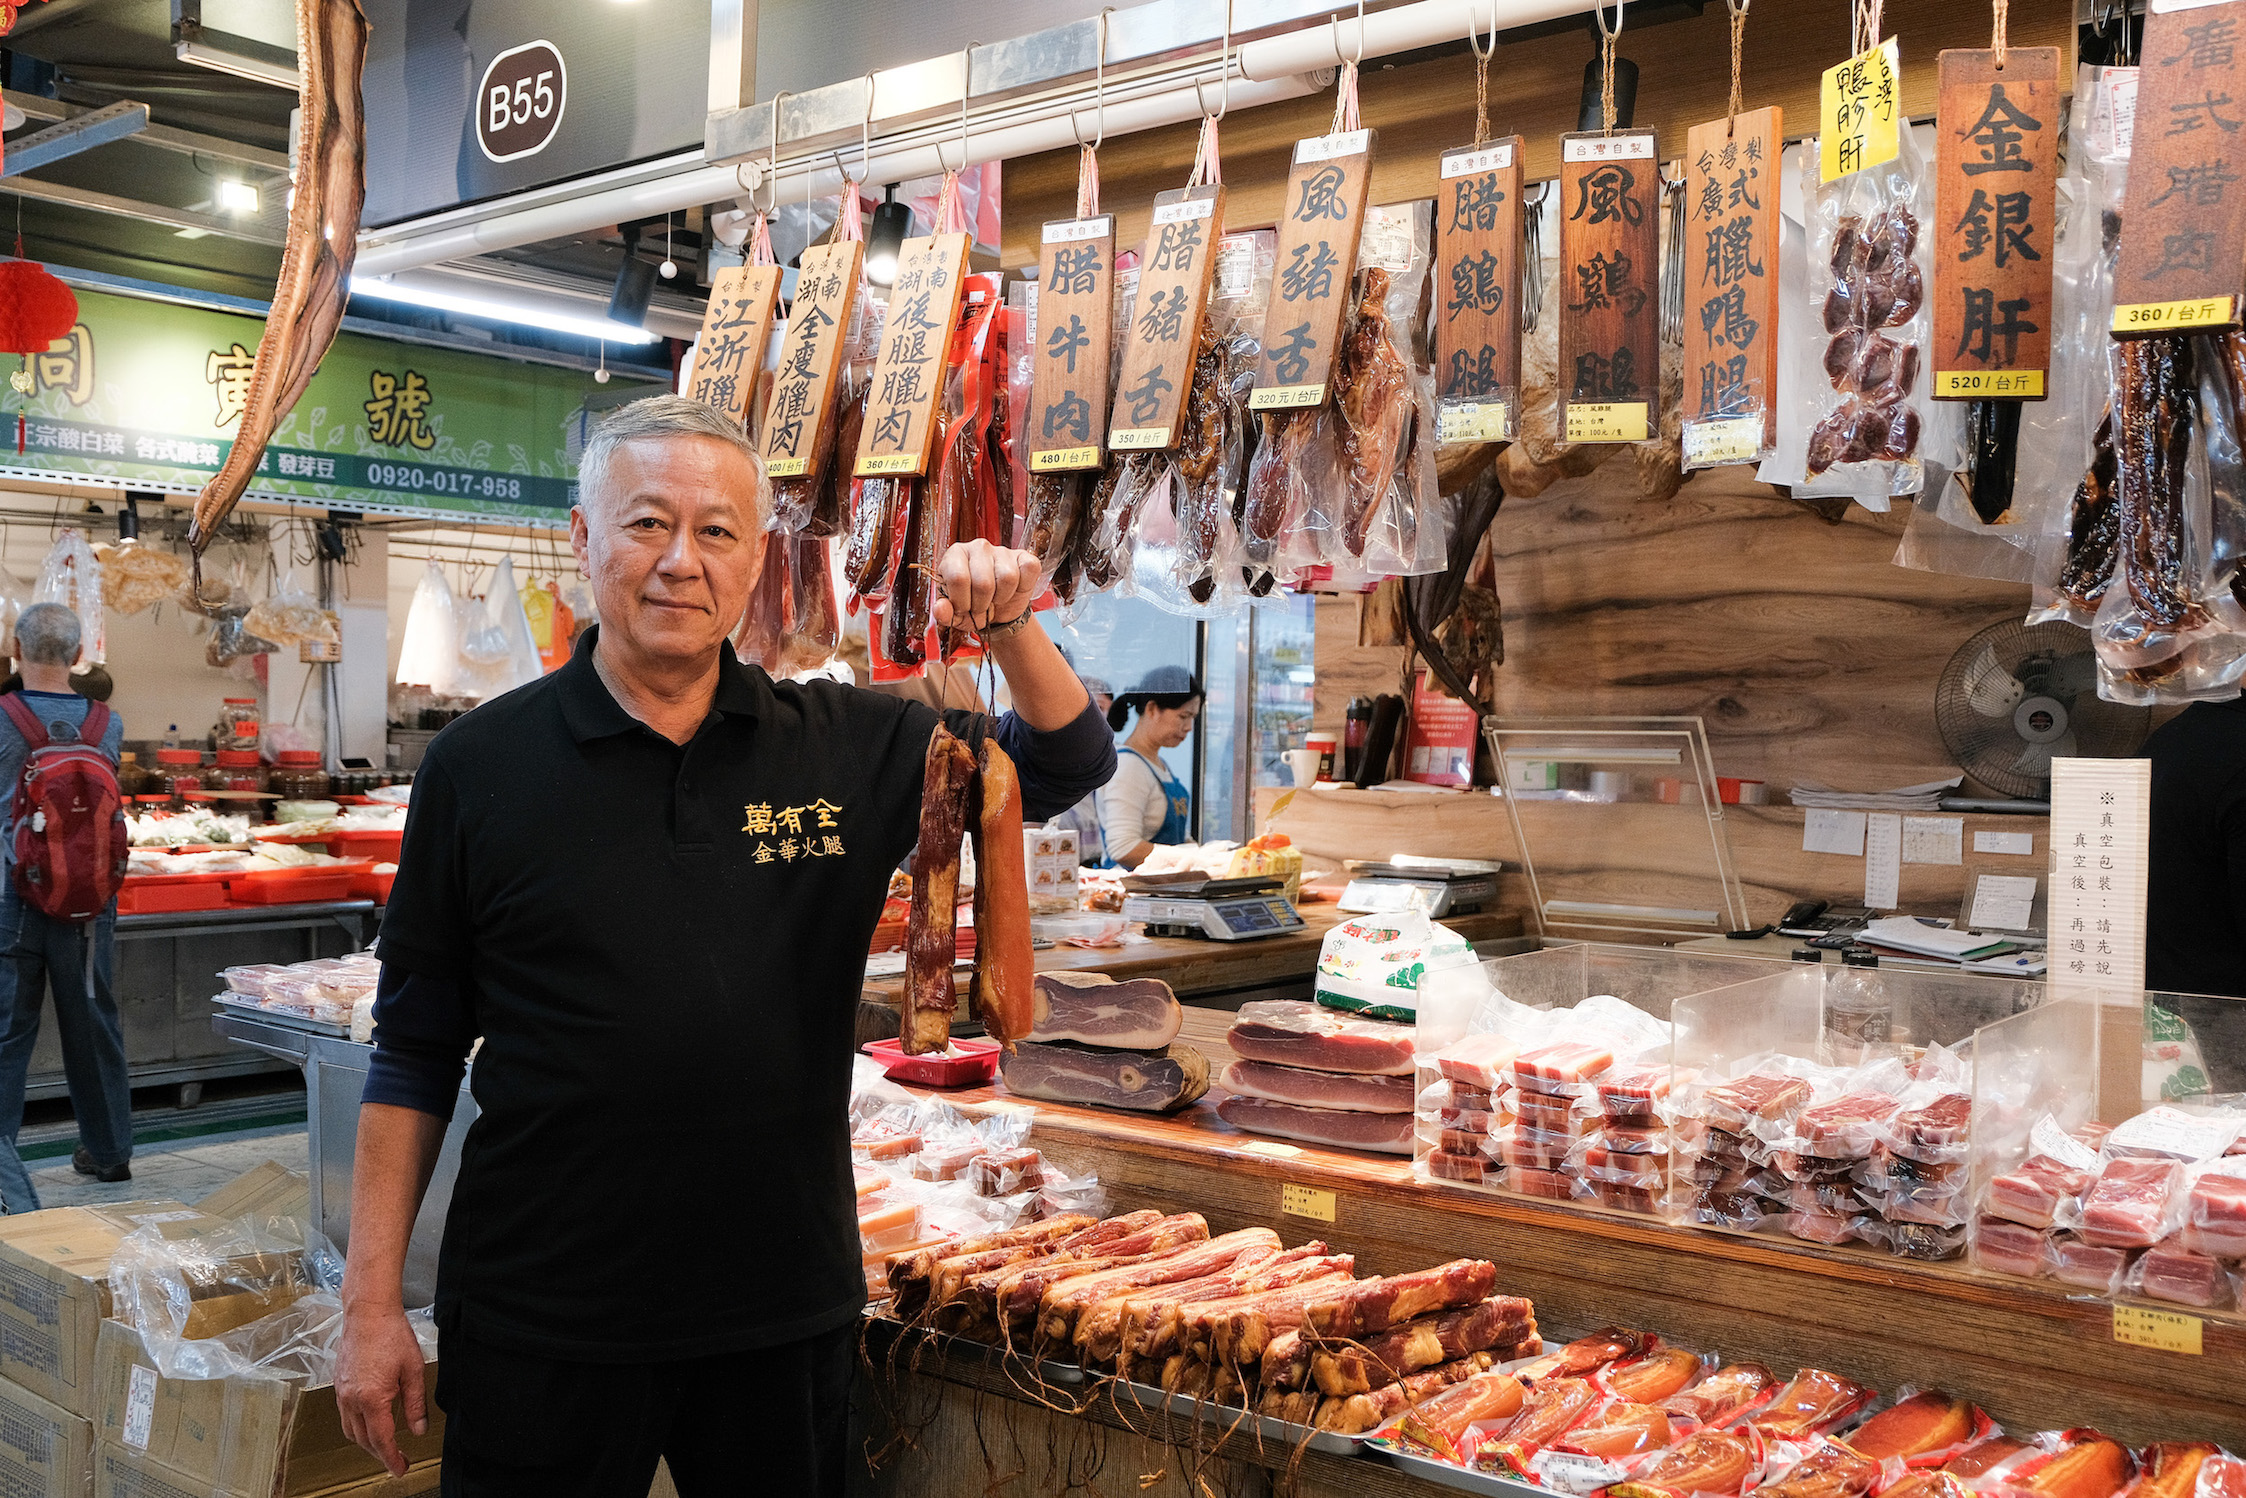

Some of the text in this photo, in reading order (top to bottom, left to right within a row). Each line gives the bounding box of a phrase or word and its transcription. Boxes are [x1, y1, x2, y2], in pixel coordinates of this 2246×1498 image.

[489, 70, 554, 133] B55
[1452, 153, 1503, 172] 台灣自製
[1575, 142, 1642, 156] 台灣自製
[1052, 224, 1100, 238] 台灣自製
[1953, 83, 2042, 370] 金銀肝
[797, 272, 842, 303] 湖南
[898, 266, 948, 293] 湖南
[1266, 165, 1347, 385] 風豬舌
[1951, 375, 2029, 390] 520/台斤
[866, 458, 910, 470] 360/台斤
[1041, 450, 1091, 463] 480/台斤
[278, 453, 335, 480] 發芽豆
[367, 463, 521, 500] 0920-017-958
[741, 797, 843, 836] 萬有全
[751, 835, 846, 864] 金華火腿
